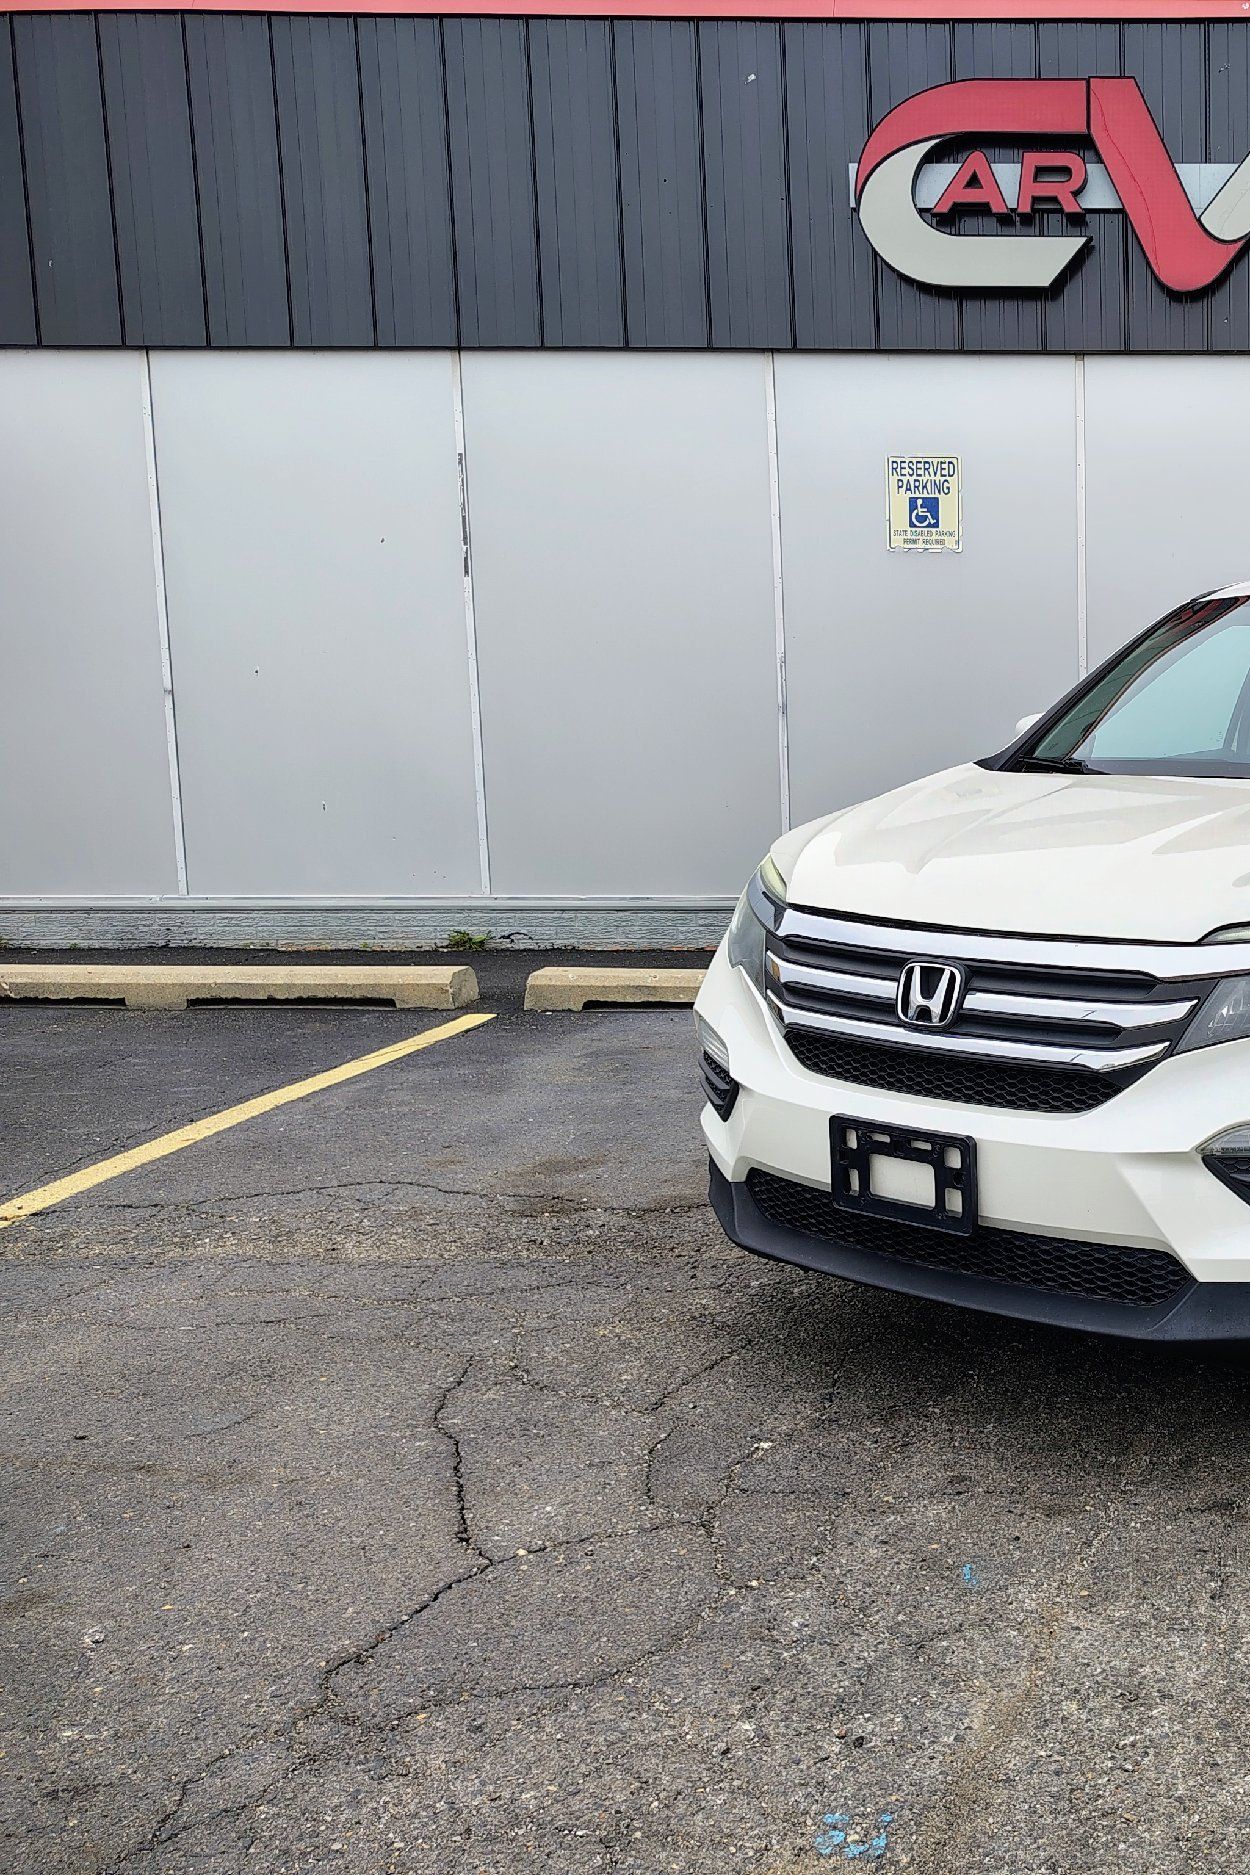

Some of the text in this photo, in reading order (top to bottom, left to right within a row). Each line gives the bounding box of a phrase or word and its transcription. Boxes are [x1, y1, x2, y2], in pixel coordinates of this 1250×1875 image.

[891, 460, 956, 478] RESERVED
[896, 478, 951, 495] PARKING
[893, 529, 956, 538] STATE DISABLED PARKING
[921, 538, 946, 546] REQUIRED
